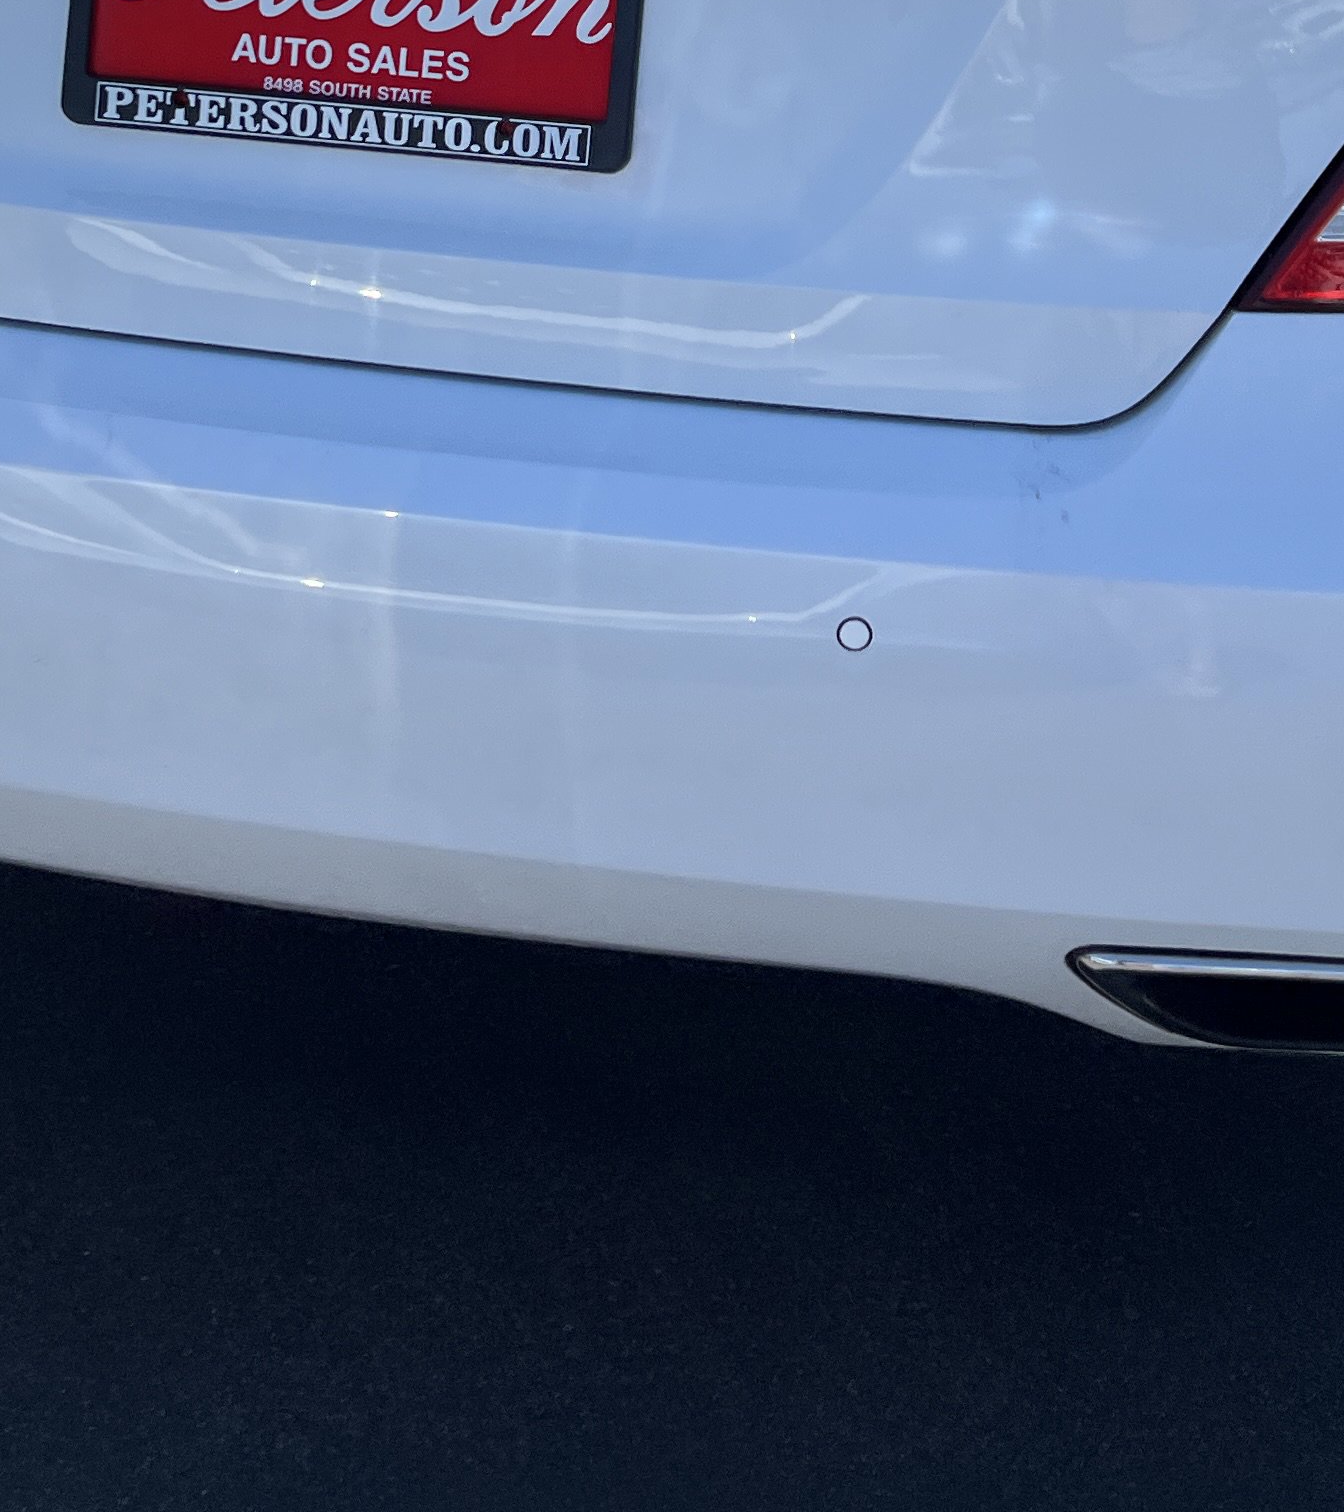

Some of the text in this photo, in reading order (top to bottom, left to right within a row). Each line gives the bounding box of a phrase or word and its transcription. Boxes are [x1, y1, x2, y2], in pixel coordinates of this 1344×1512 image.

[231, 33, 470, 82] AUTO SALES
[263, 76, 432, 105] 8498 SOUTH STATE
